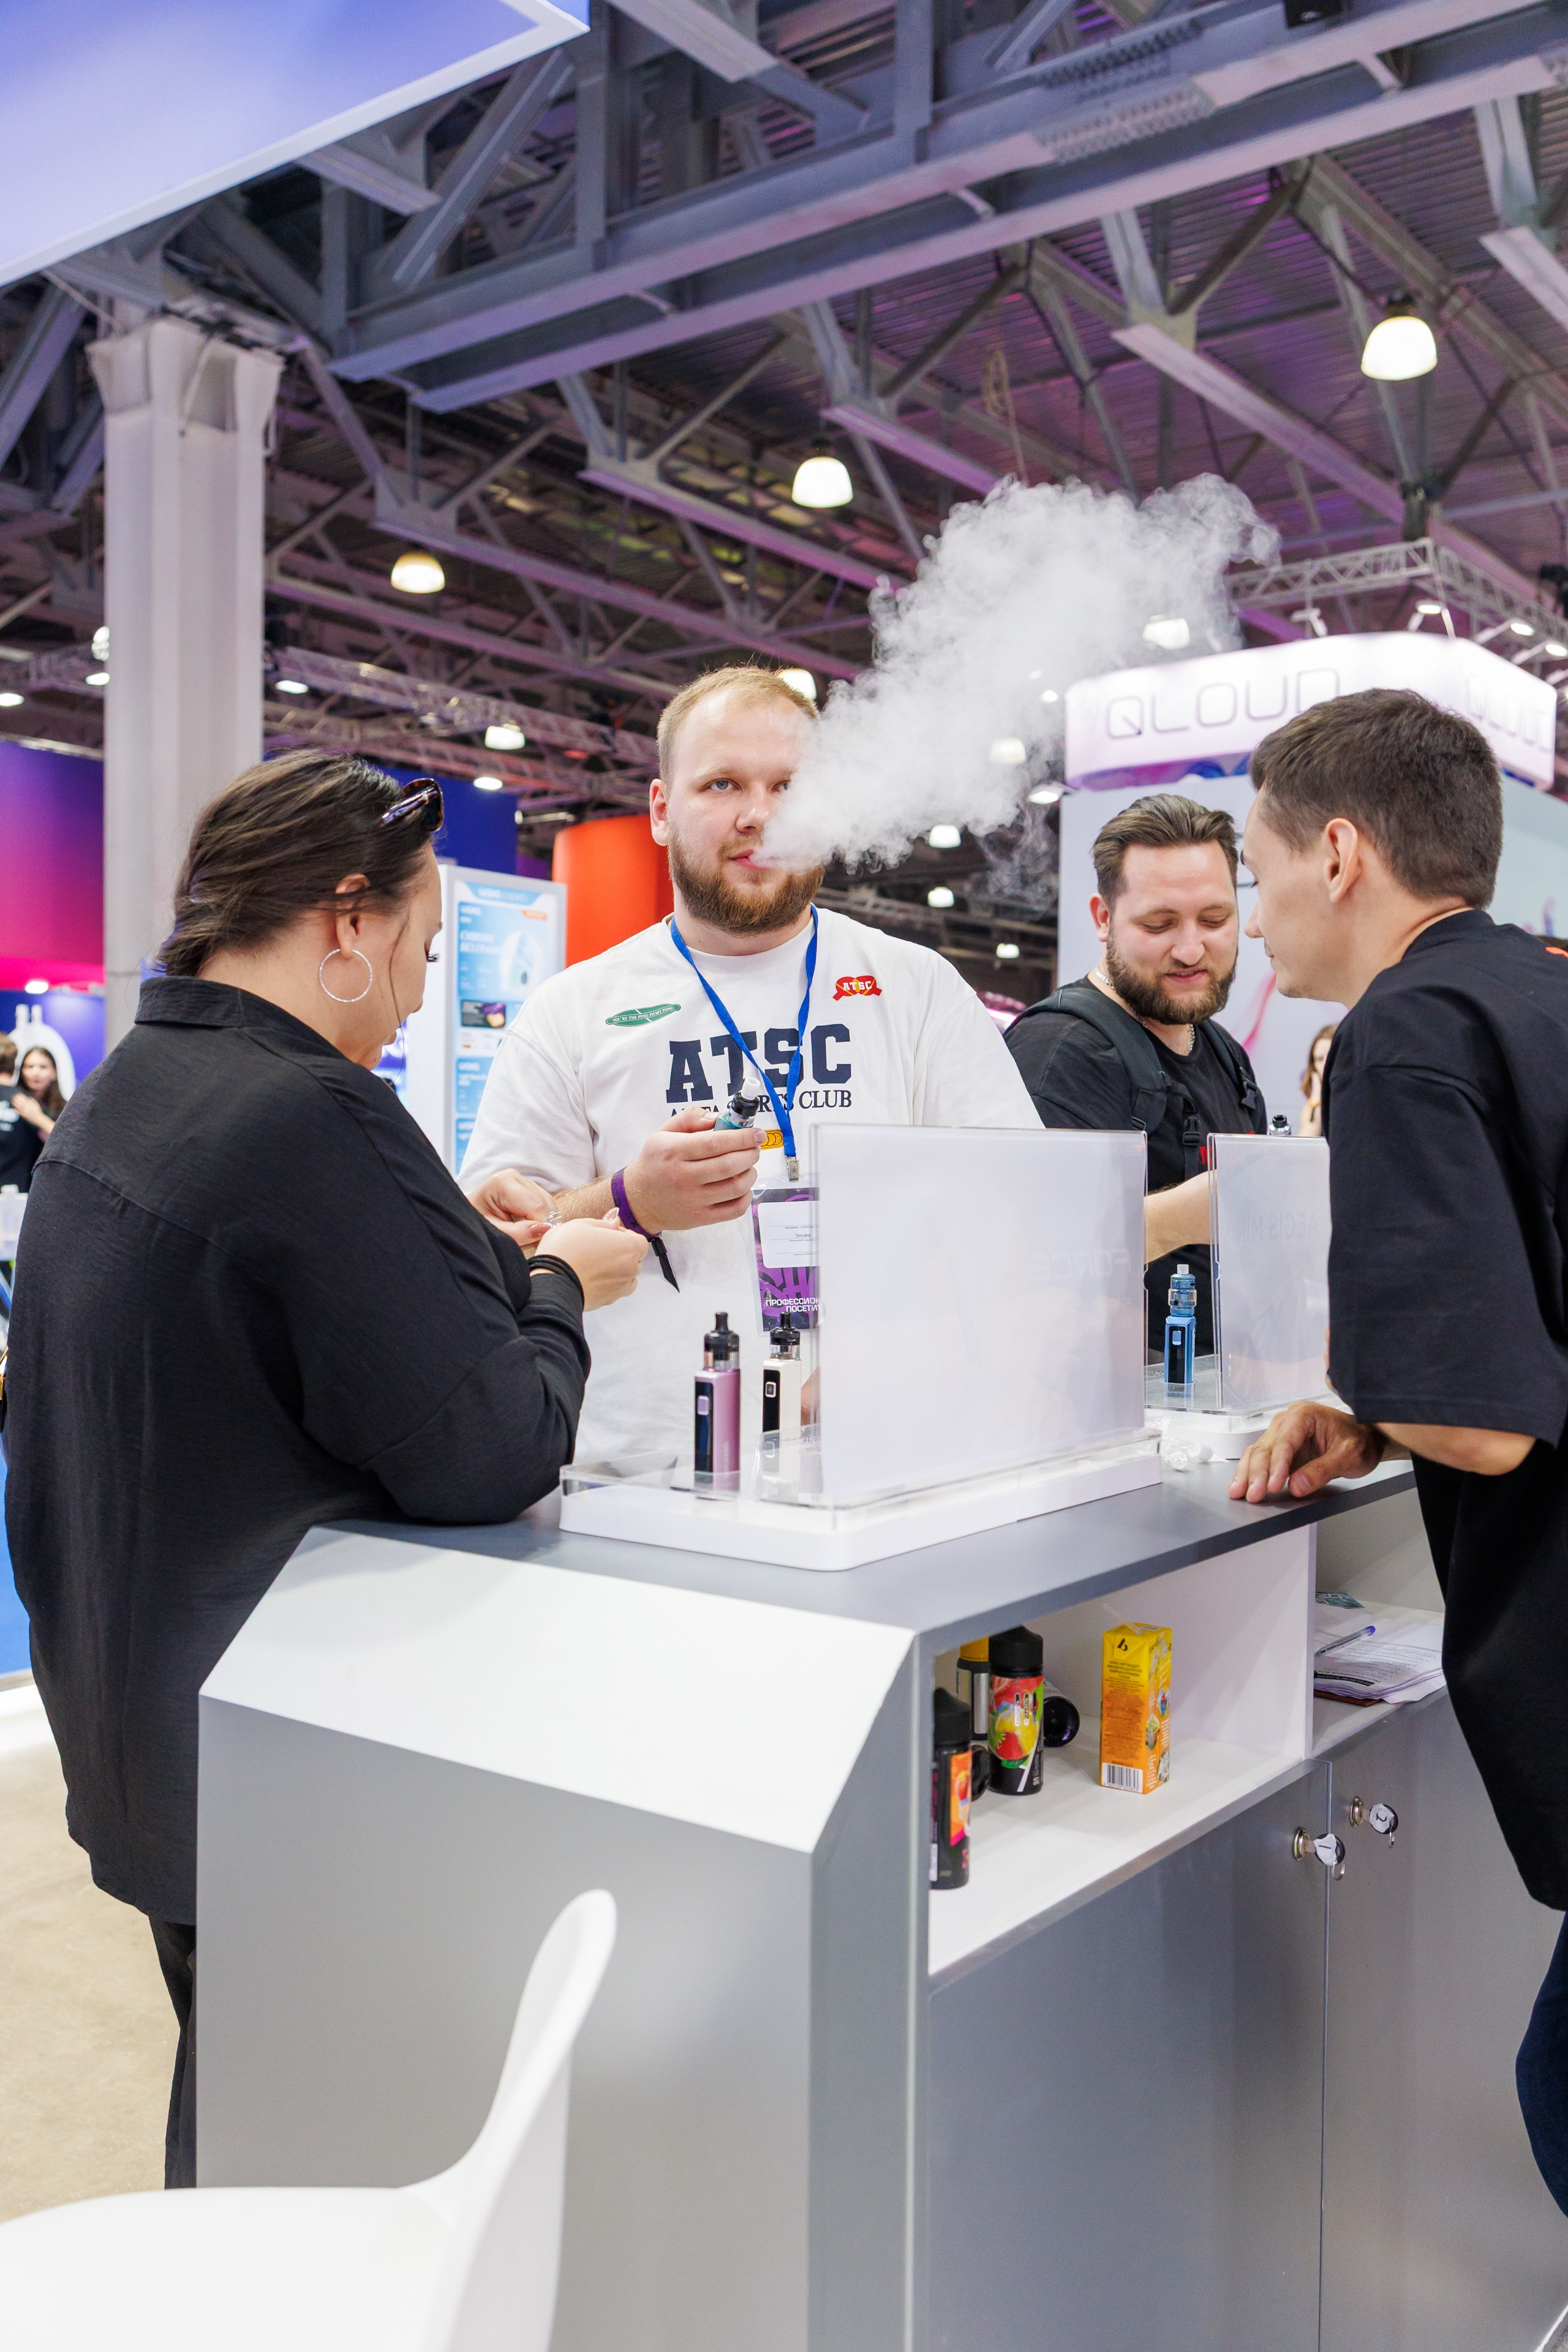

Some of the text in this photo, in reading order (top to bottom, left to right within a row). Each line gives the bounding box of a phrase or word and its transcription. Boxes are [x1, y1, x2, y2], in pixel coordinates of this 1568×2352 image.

[1105, 668, 1340, 739] QLOUD
[843, 981, 872, 991] ATSC
[666, 1023, 852, 1103] ATSC
[799, 1090, 852, 1109] CLUB
[1376, 1812, 1387, 1822] 2
